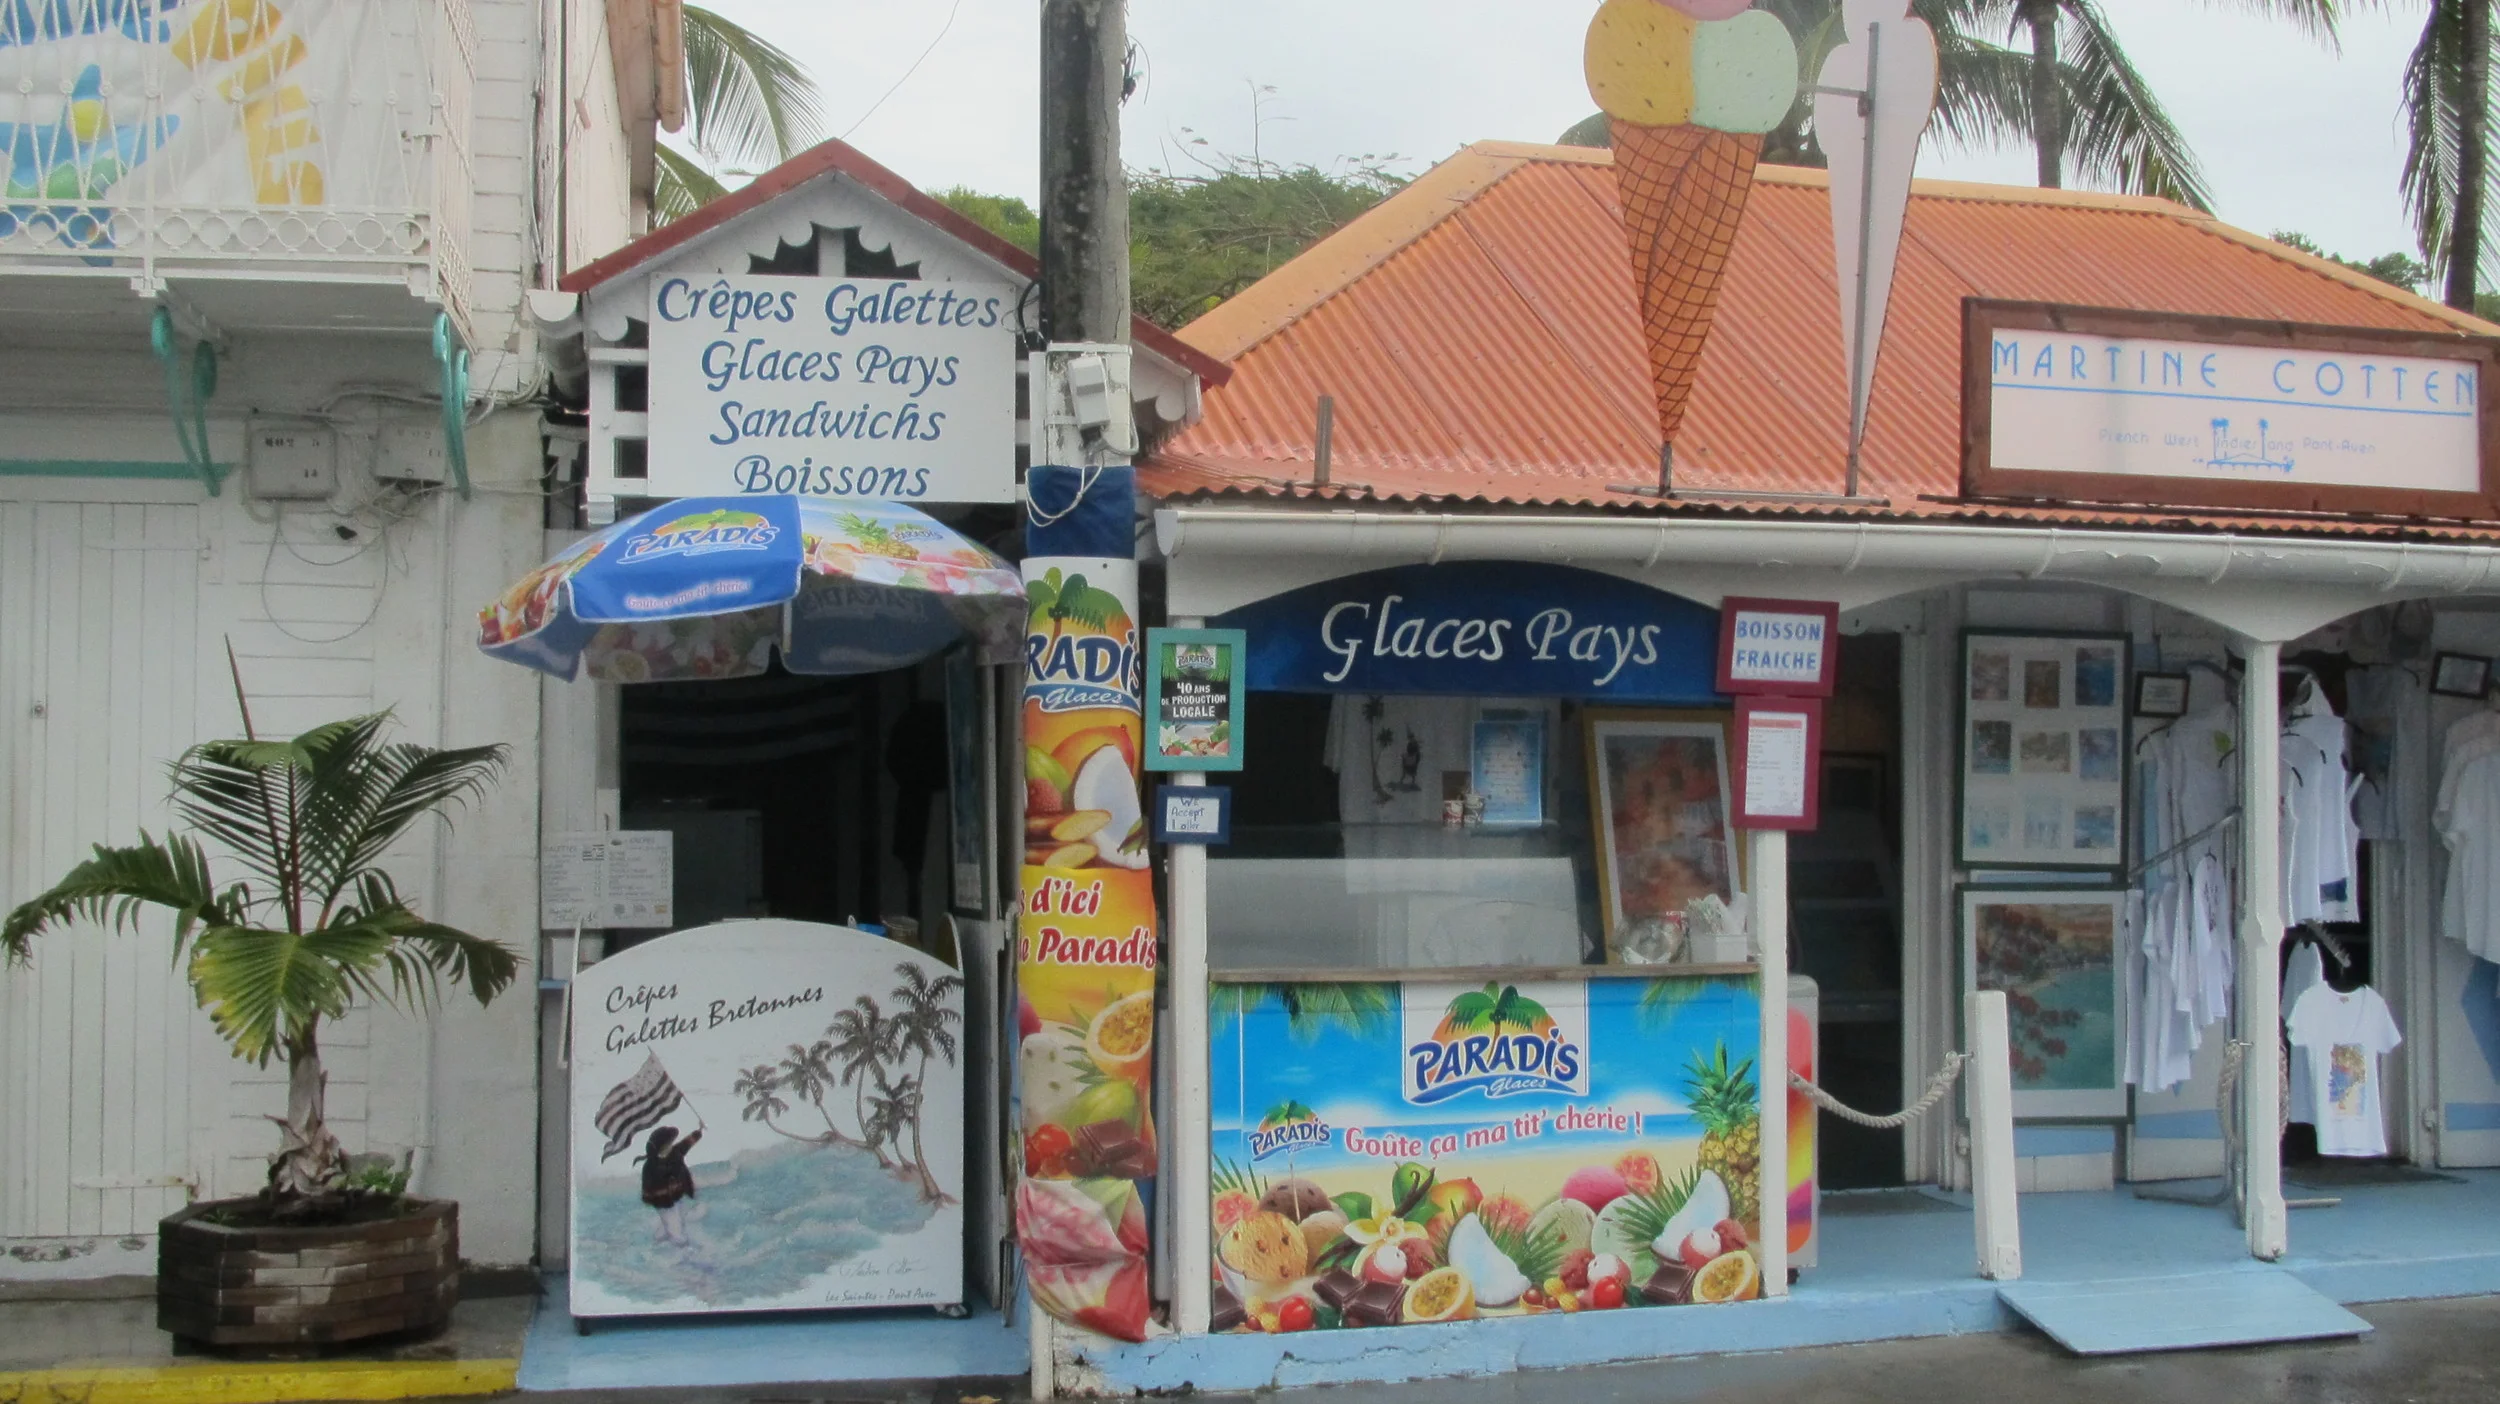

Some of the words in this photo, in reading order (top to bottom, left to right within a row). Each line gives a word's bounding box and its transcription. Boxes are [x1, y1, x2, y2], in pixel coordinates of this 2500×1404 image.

[657, 279, 797, 332] Crêpes
[823, 282, 999, 336] Galettes
[701, 339, 842, 391] Glaces
[856, 344, 959, 397] Pays
[1993, 340, 2217, 388] MARTINE
[2272, 359, 2476, 406] COTTEN
[709, 400, 946, 445] Sandwichs
[734, 454, 930, 496] Boissons
[1321, 595, 1512, 683] Glaces
[1526, 608, 1661, 686] Pays
[1737, 621, 1821, 641] BOISSON
[1737, 650, 1817, 670] FRAICHE
[1046, 687, 1123, 711] Glaces
[1161, 698, 1169, 706] DE
[1172, 695, 1227, 705] PRODUCTION
[1177, 682, 1192, 694] 40
[1194, 685, 1211, 694] ANS
[1173, 706, 1216, 718] LOCALE
[1031, 877, 1102, 916] d'ici
[1037, 927, 1156, 970] Paradis
[606, 983, 678, 1013] Crêpes
[605, 1014, 699, 1053] Galettes
[708, 985, 824, 1031] Bretonnes
[1490, 1076, 1548, 1097] Glaces
[1345, 1127, 1422, 1157] Goûte
[1429, 1138, 1457, 1161] ça
[1465, 1123, 1506, 1149] ma
[1555, 1104, 1627, 1132] chérie
[1633, 1111, 1643, 1135] !
